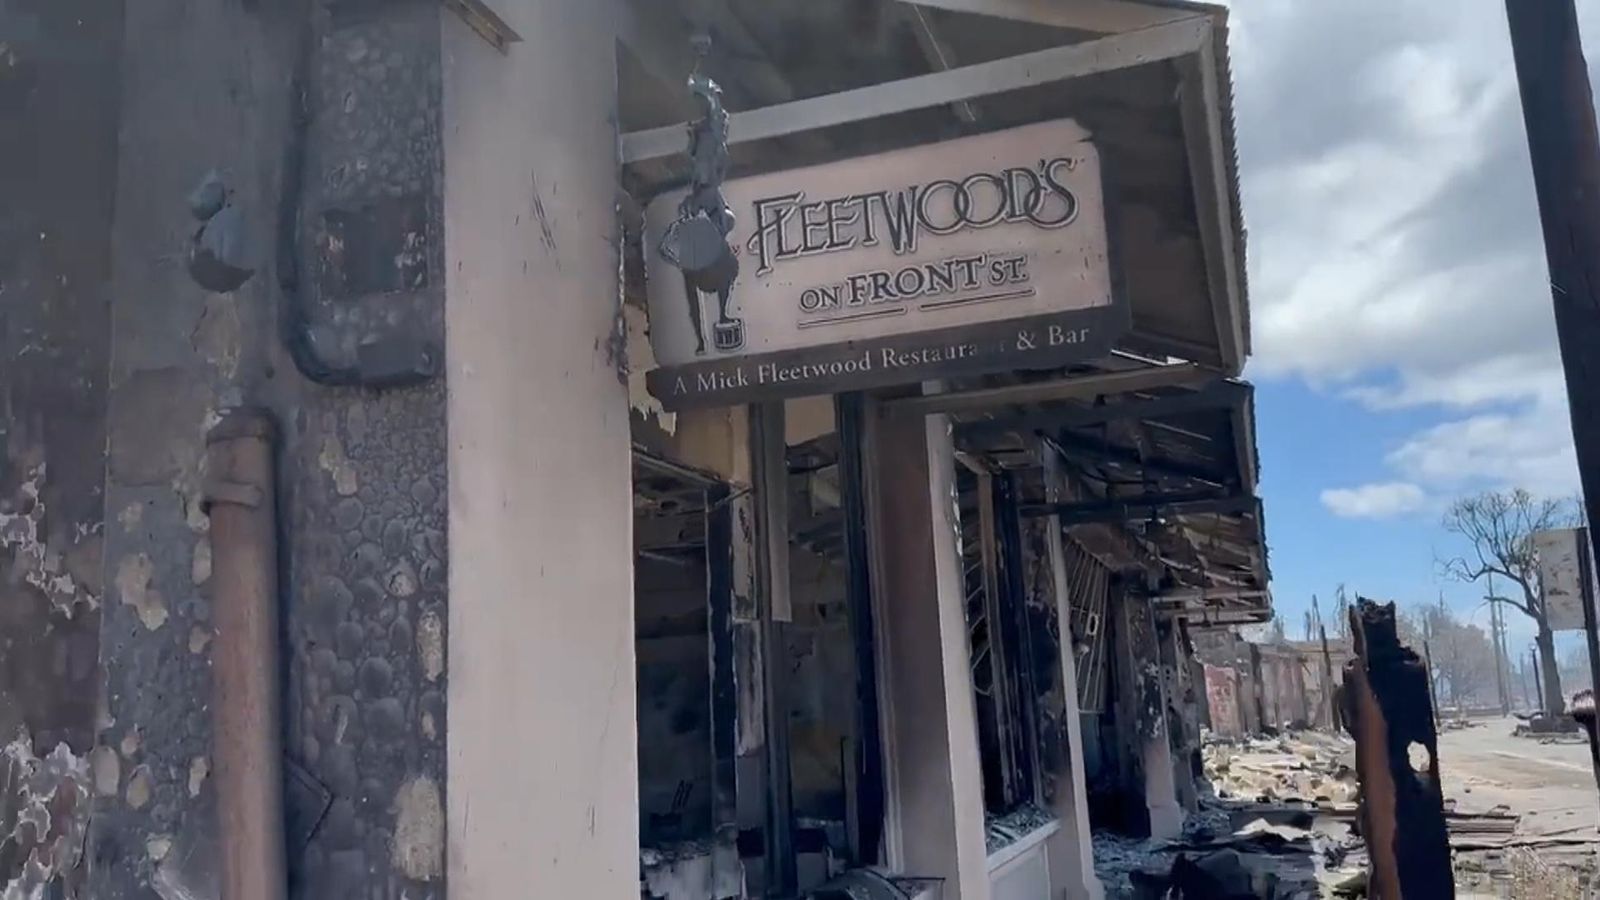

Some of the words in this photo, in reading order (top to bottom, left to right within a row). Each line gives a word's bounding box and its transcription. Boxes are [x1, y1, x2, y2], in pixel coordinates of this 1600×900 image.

[746, 158, 1079, 276] FLEETWOOD'S
[800, 285, 841, 311] ON
[846, 254, 986, 303] FRONT
[990, 256, 1028, 284] ST.
[673, 374, 688, 396] A
[697, 367, 750, 392] Mick
[757, 350, 872, 385] Fleetwood
[881, 338, 1005, 369] Restaura
[1016, 328, 1037, 351] &
[1048, 324, 1090, 347] Bar
